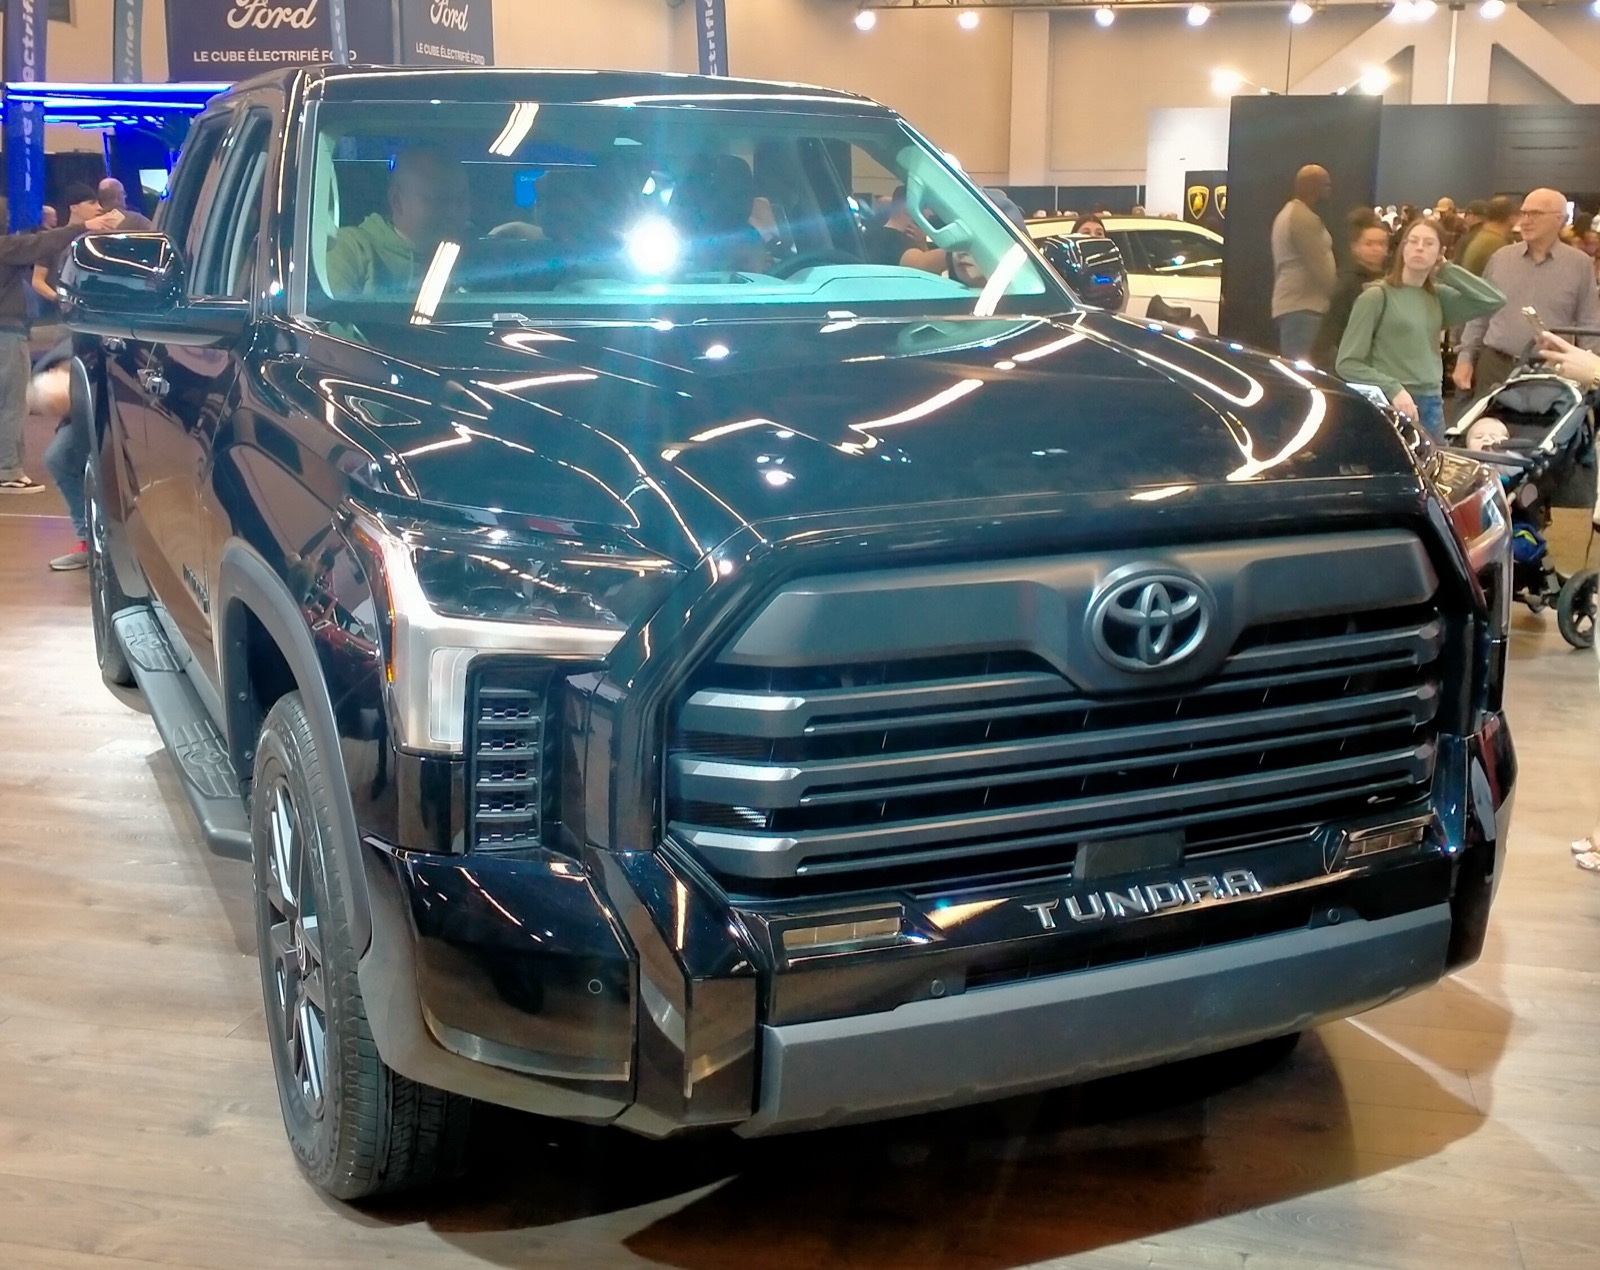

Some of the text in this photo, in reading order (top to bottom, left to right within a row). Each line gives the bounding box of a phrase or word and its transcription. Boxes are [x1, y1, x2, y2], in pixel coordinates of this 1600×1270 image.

[227, 0, 317, 29] Ford
[430, 0, 469, 32] Ford
[193, 48, 357, 62] LE CUBE ÉLECTRIFIÉ FD
[415, 41, 424, 54] LE
[424, 43, 441, 57] CUBE
[1023, 869, 1263, 930] TUNDRA
